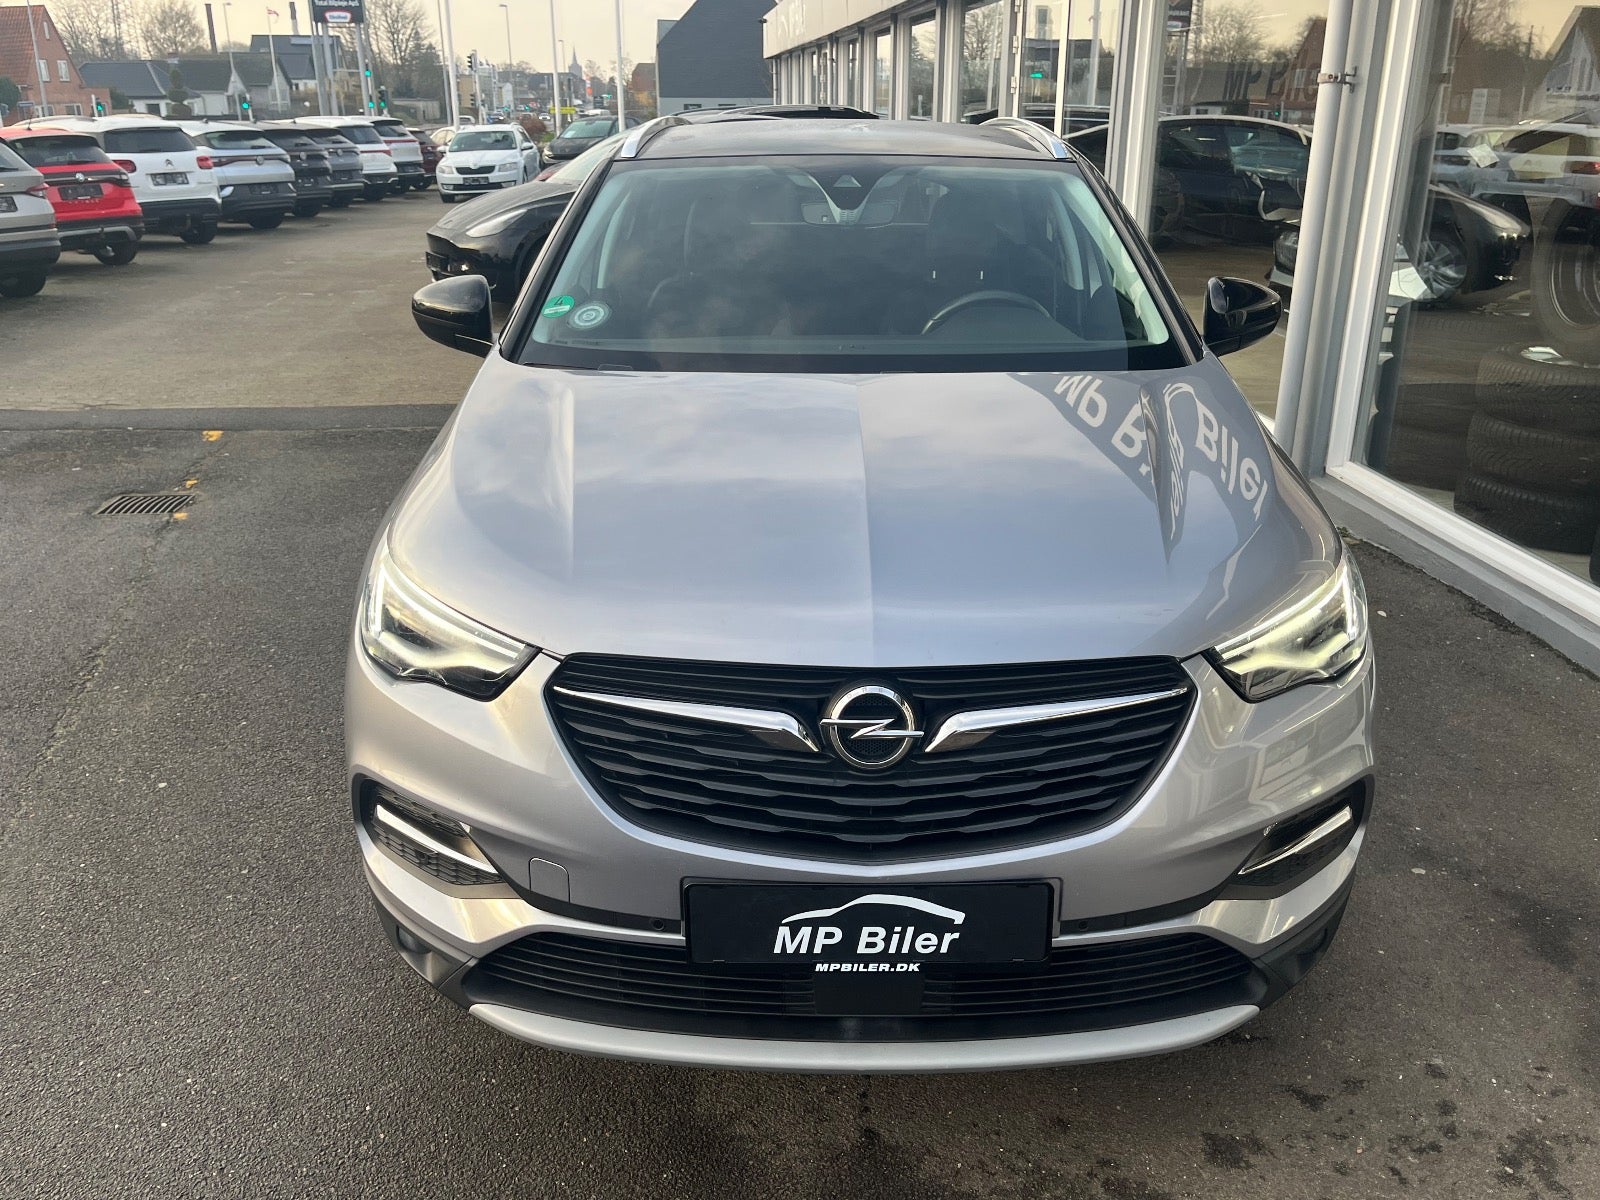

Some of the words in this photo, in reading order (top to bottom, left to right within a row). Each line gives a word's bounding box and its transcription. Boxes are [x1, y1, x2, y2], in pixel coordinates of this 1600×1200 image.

[773, 926, 842, 954] MP
[856, 926, 960, 954] Biler
[815, 963, 920, 972] MPBILER.DK
